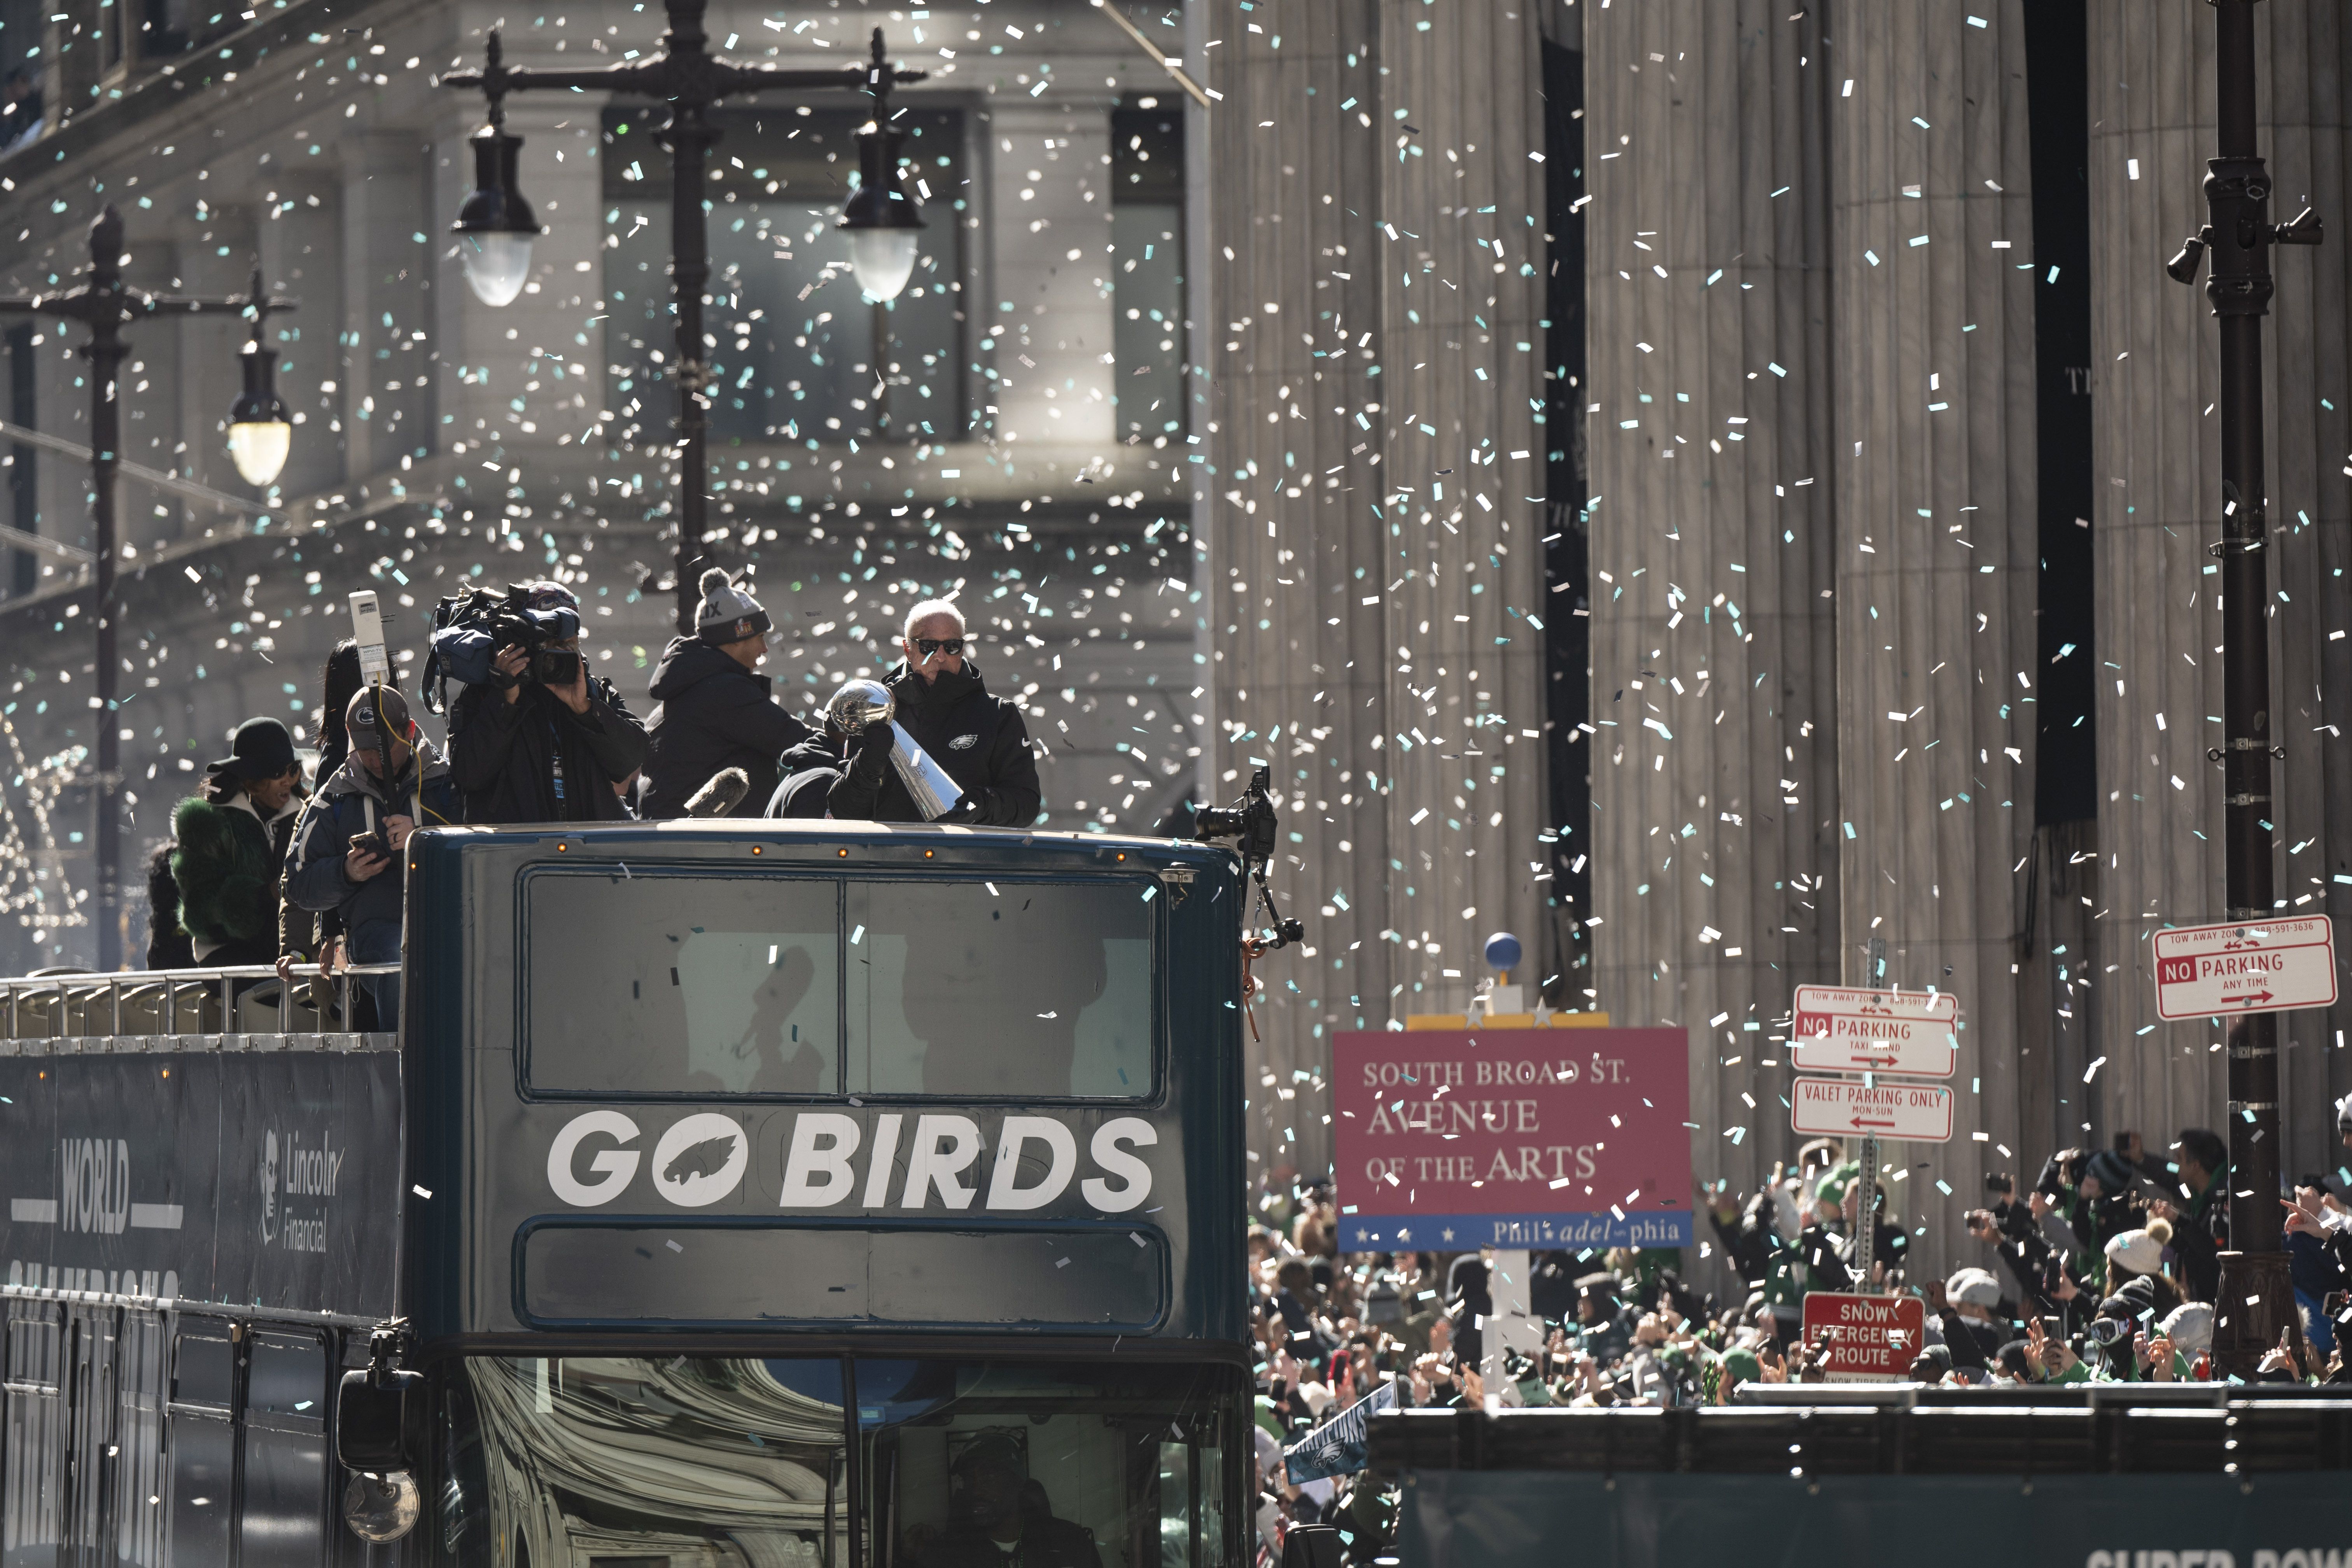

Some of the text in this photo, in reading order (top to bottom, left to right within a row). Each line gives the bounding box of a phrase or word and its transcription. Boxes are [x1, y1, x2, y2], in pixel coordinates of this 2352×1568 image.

[2170, 934, 2189, 944] TOW
[2193, 931, 2217, 942] AWAY
[2221, 928, 2244, 938] ZON
[2165, 954, 2283, 981] NO PARKING
[2223, 977, 2268, 990] ANY TIME
[1812, 992, 1829, 1001] TOW
[1833, 993, 1855, 1002] AWAY
[1803, 1017, 1911, 1040] NO PARKING
[1850, 1041, 1869, 1050] TAXI
[1363, 1059, 1631, 1088] SOUTH BROAD ST.
[1805, 1084, 1942, 1108] VALET PARKING ONLY
[1367, 1099, 1540, 1134] AVENUE
[1852, 1105, 1893, 1116] MON-SUN
[286, 1130, 336, 1196] Lincoln
[548, 1110, 1158, 1213] GO BIRDS
[1365, 1144, 1596, 1182] OF THE ARTS
[62, 1138, 130, 1234] WORLD
[284, 1206, 327, 1253] Financial
[1840, 1304, 1888, 1323] SNOW
[1835, 1346, 1890, 1366] ROUTE
